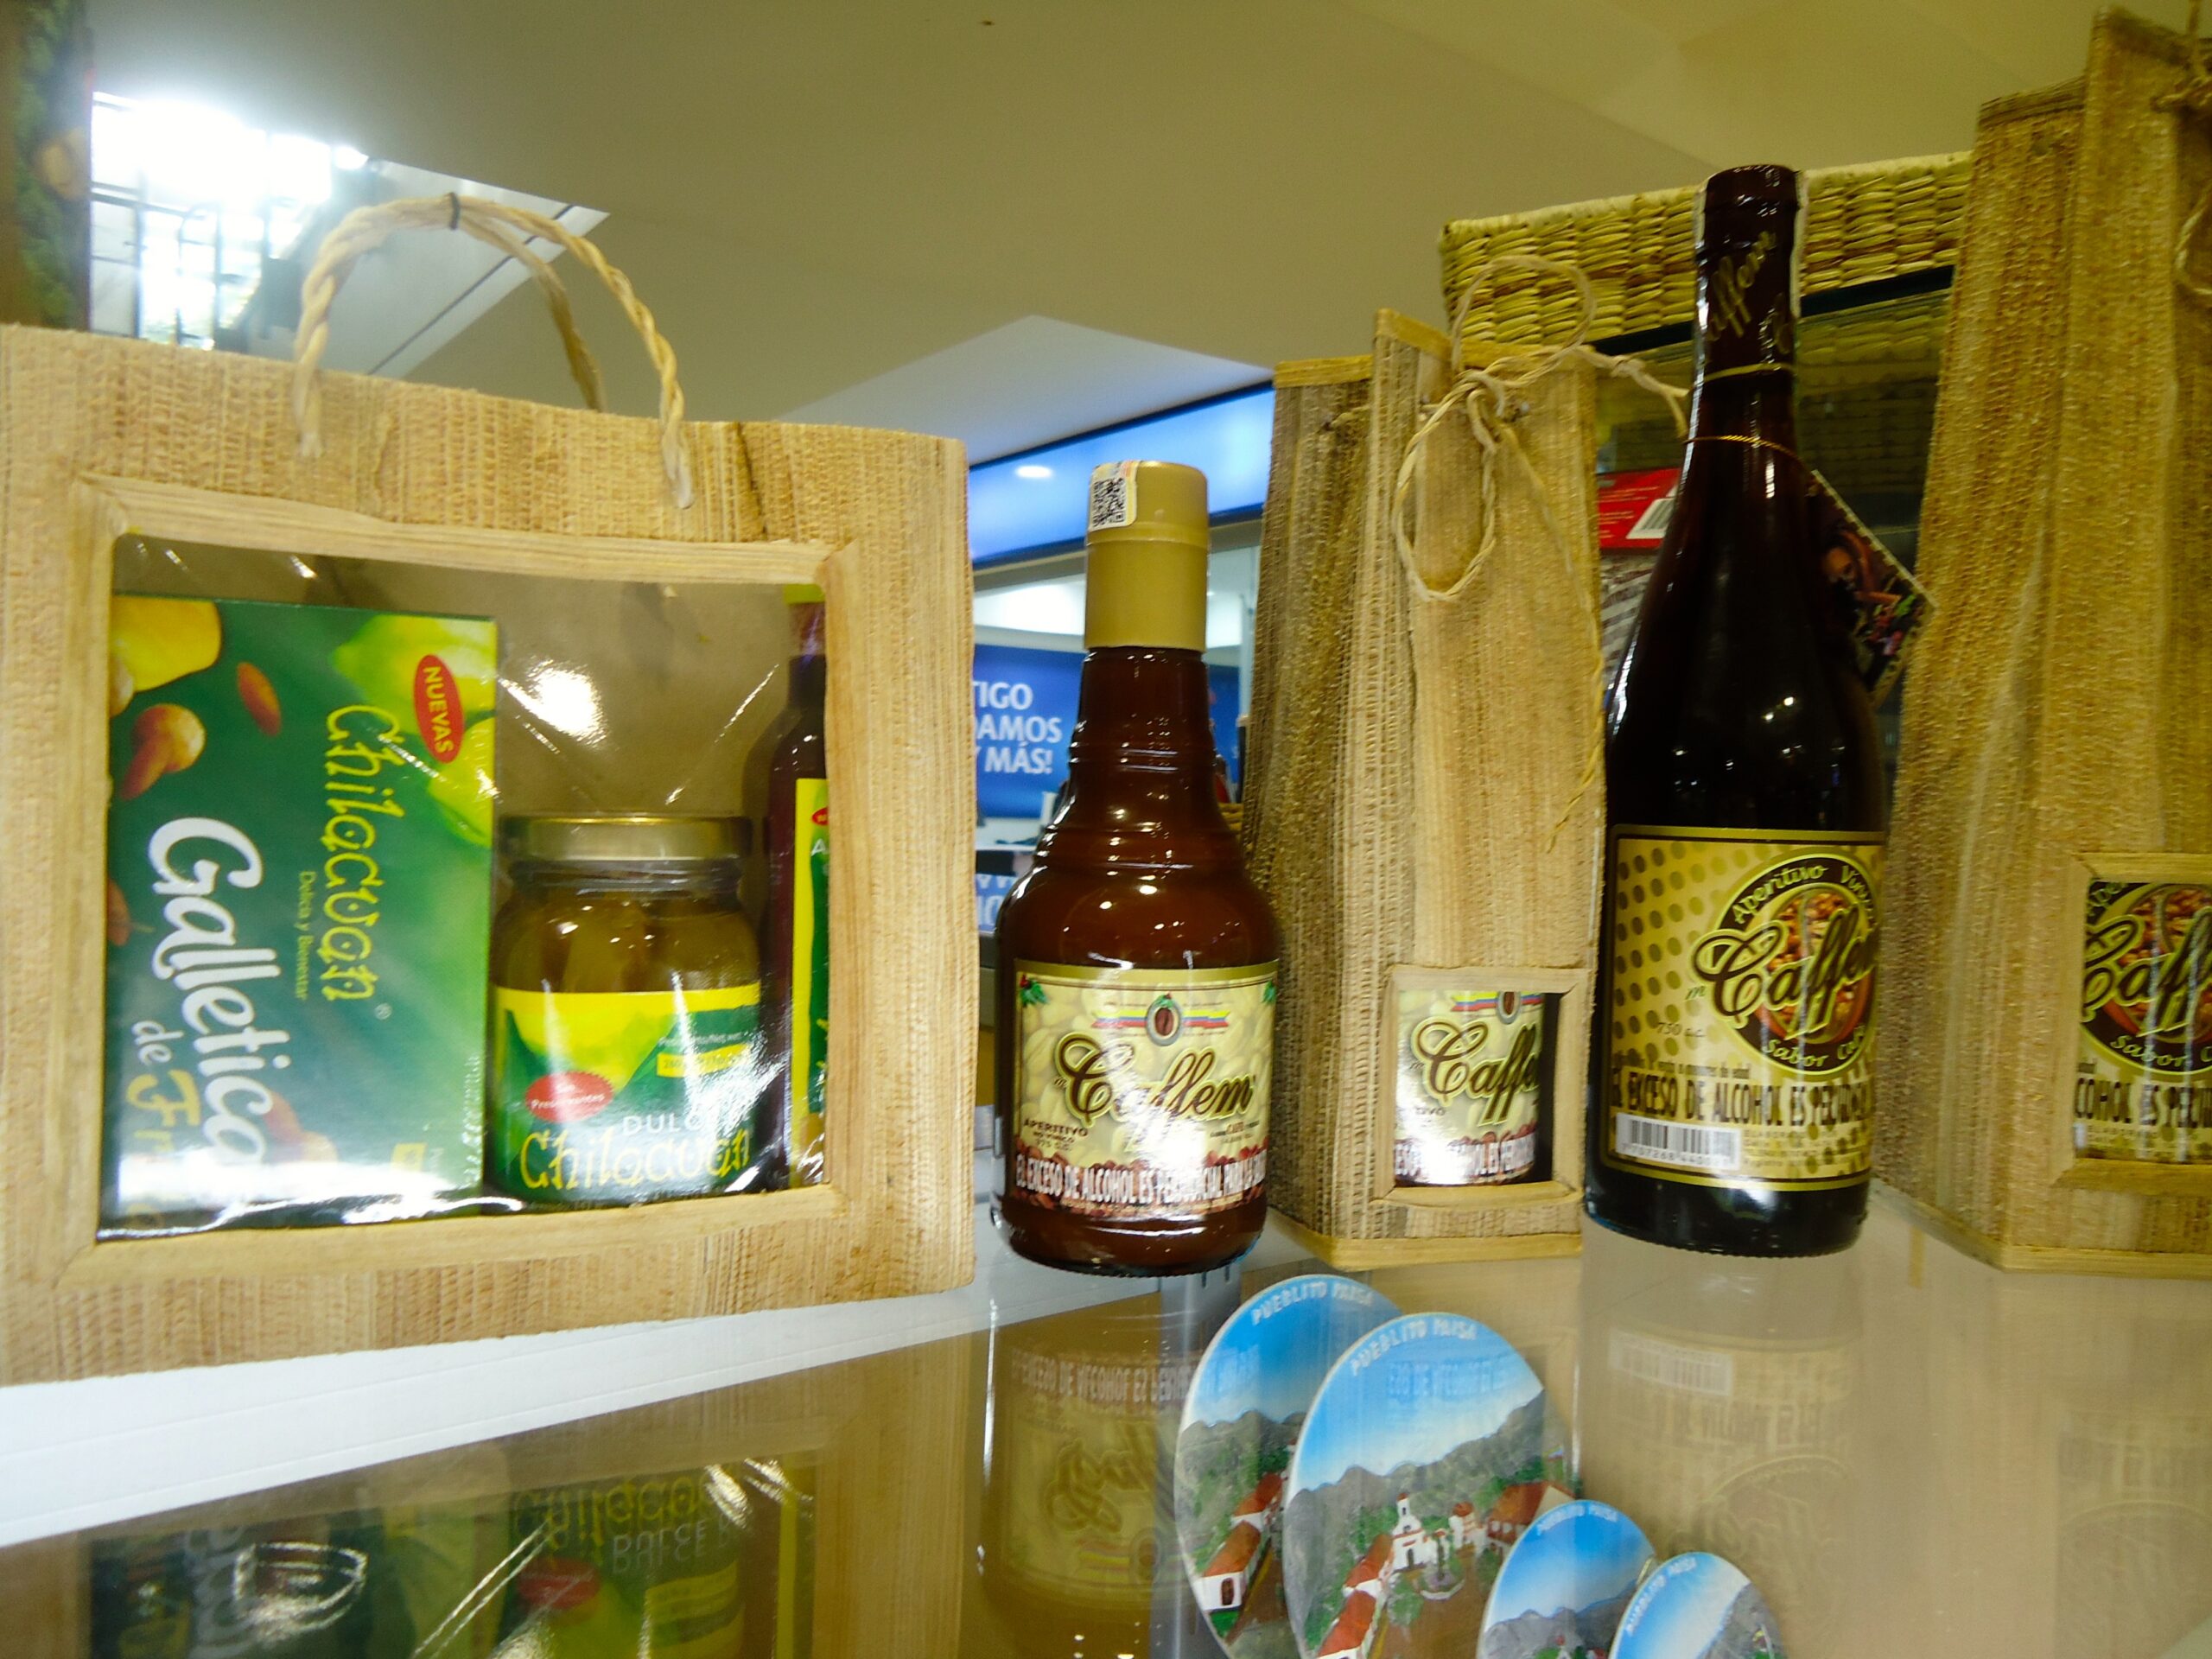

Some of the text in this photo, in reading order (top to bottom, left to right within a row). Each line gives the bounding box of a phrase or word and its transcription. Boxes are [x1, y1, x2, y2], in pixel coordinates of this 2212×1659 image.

[423, 665, 456, 755] NUEVAS
[976, 713, 1063, 743] AMOS
[984, 741, 1053, 774] MÁS!
[320, 704, 406, 1003] Chilacuan
[130, 1020, 185, 1065] de
[1762, 1039, 1829, 1069] Sabor
[2110, 1034, 2191, 1067] Sabor
[520, 1126, 751, 1191] Chilacuan
